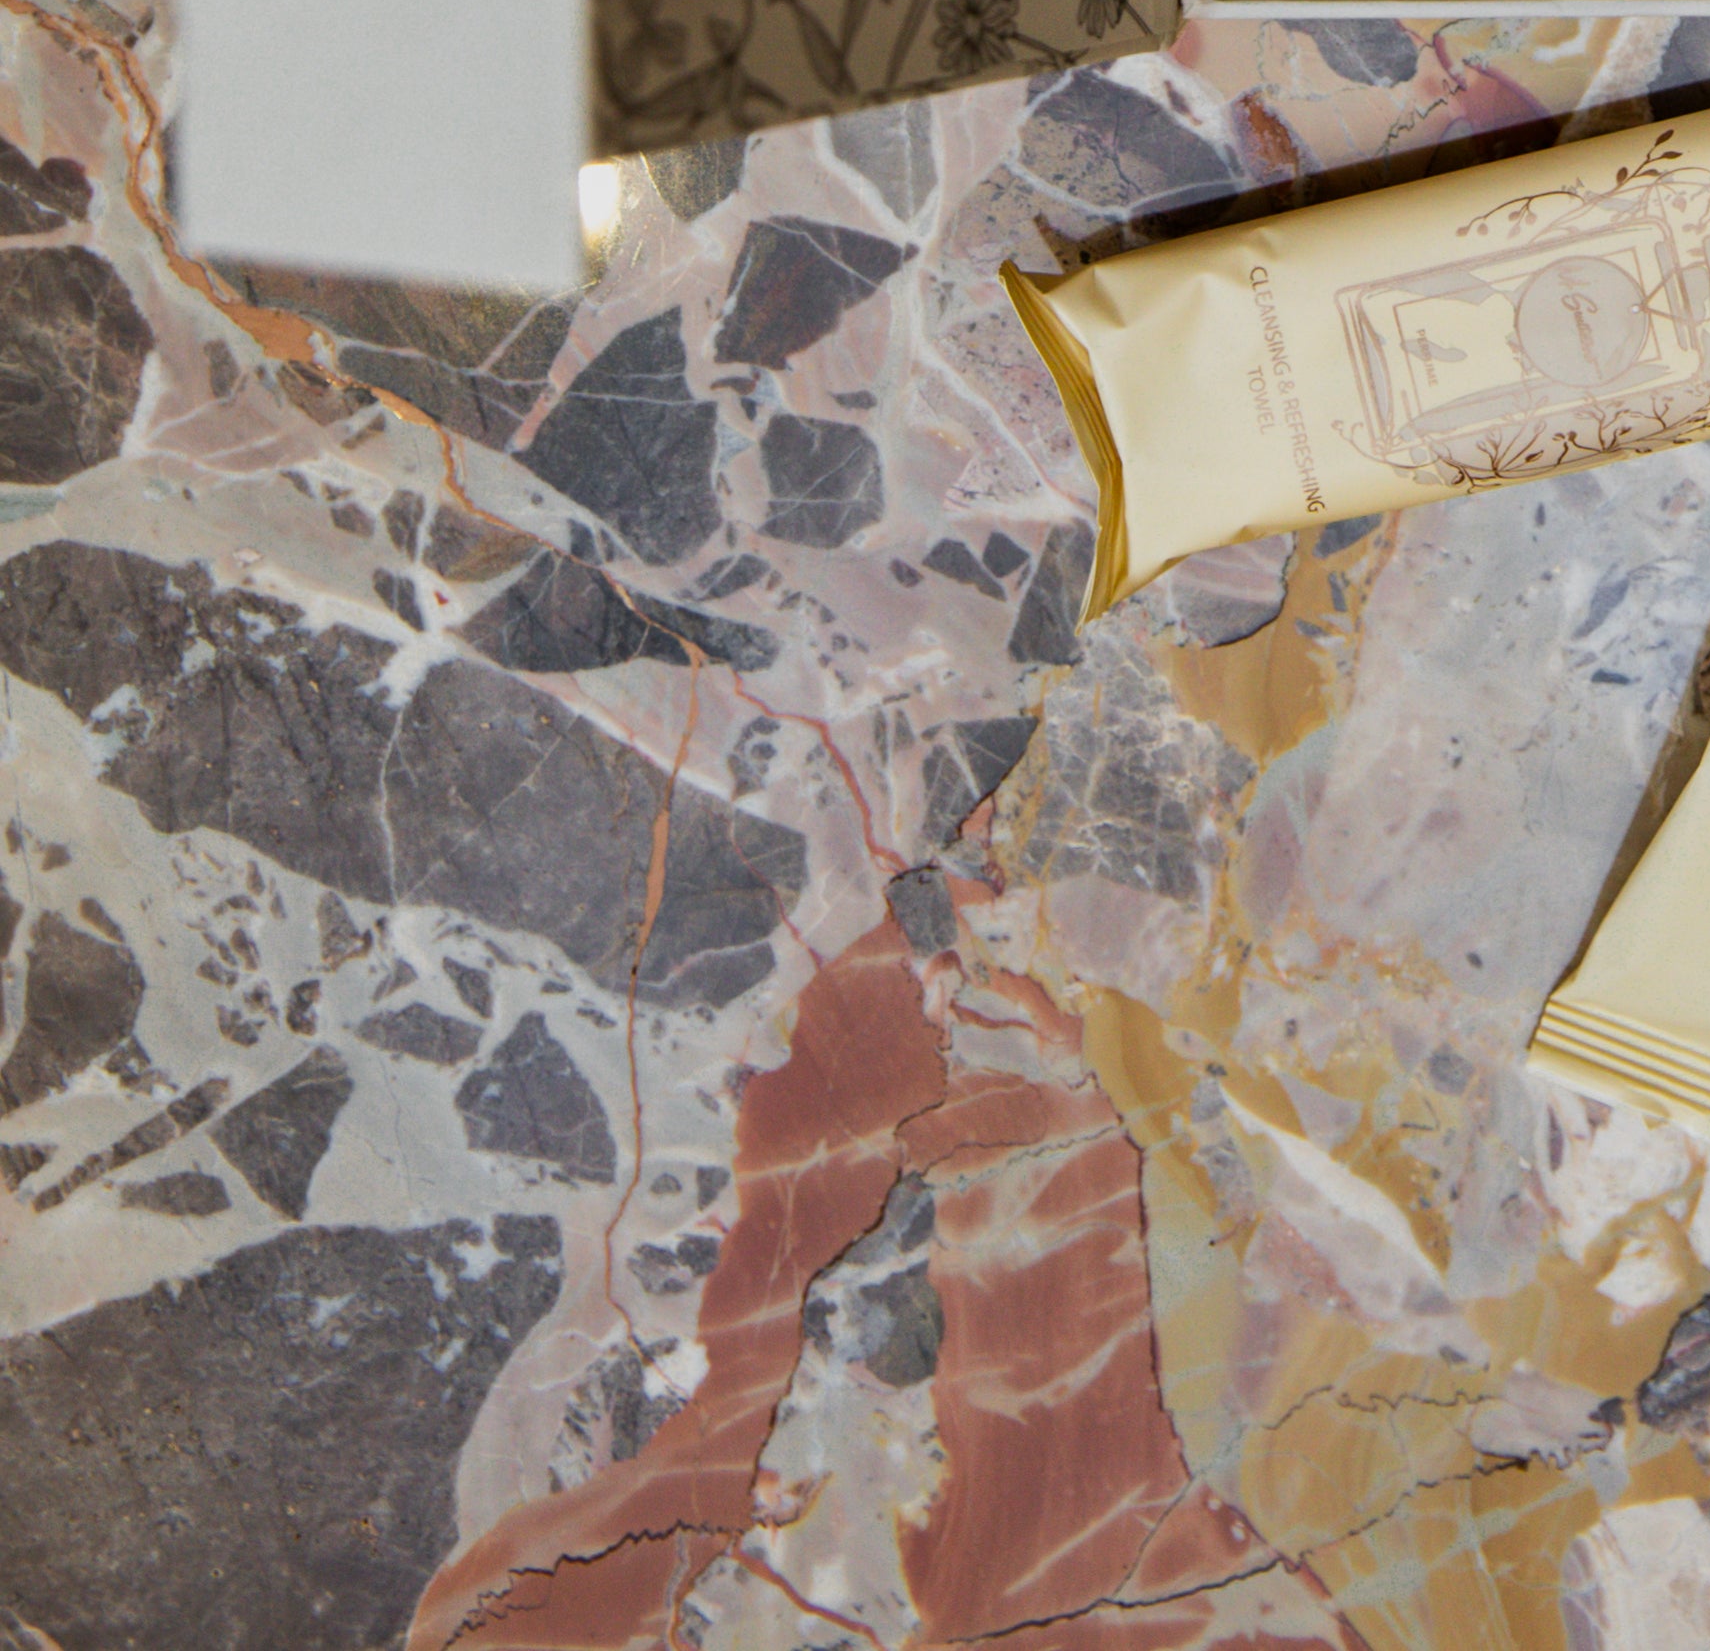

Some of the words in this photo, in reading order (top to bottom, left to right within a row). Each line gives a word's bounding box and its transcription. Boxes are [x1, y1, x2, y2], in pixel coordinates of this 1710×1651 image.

[1250, 266, 1292, 376] CLEANSING
[1277, 381, 1295, 396] &
[1416, 329, 1438, 388] PERFUME
[1246, 365, 1275, 435] TOWEL
[1283, 397, 1326, 514] REFRESHING
